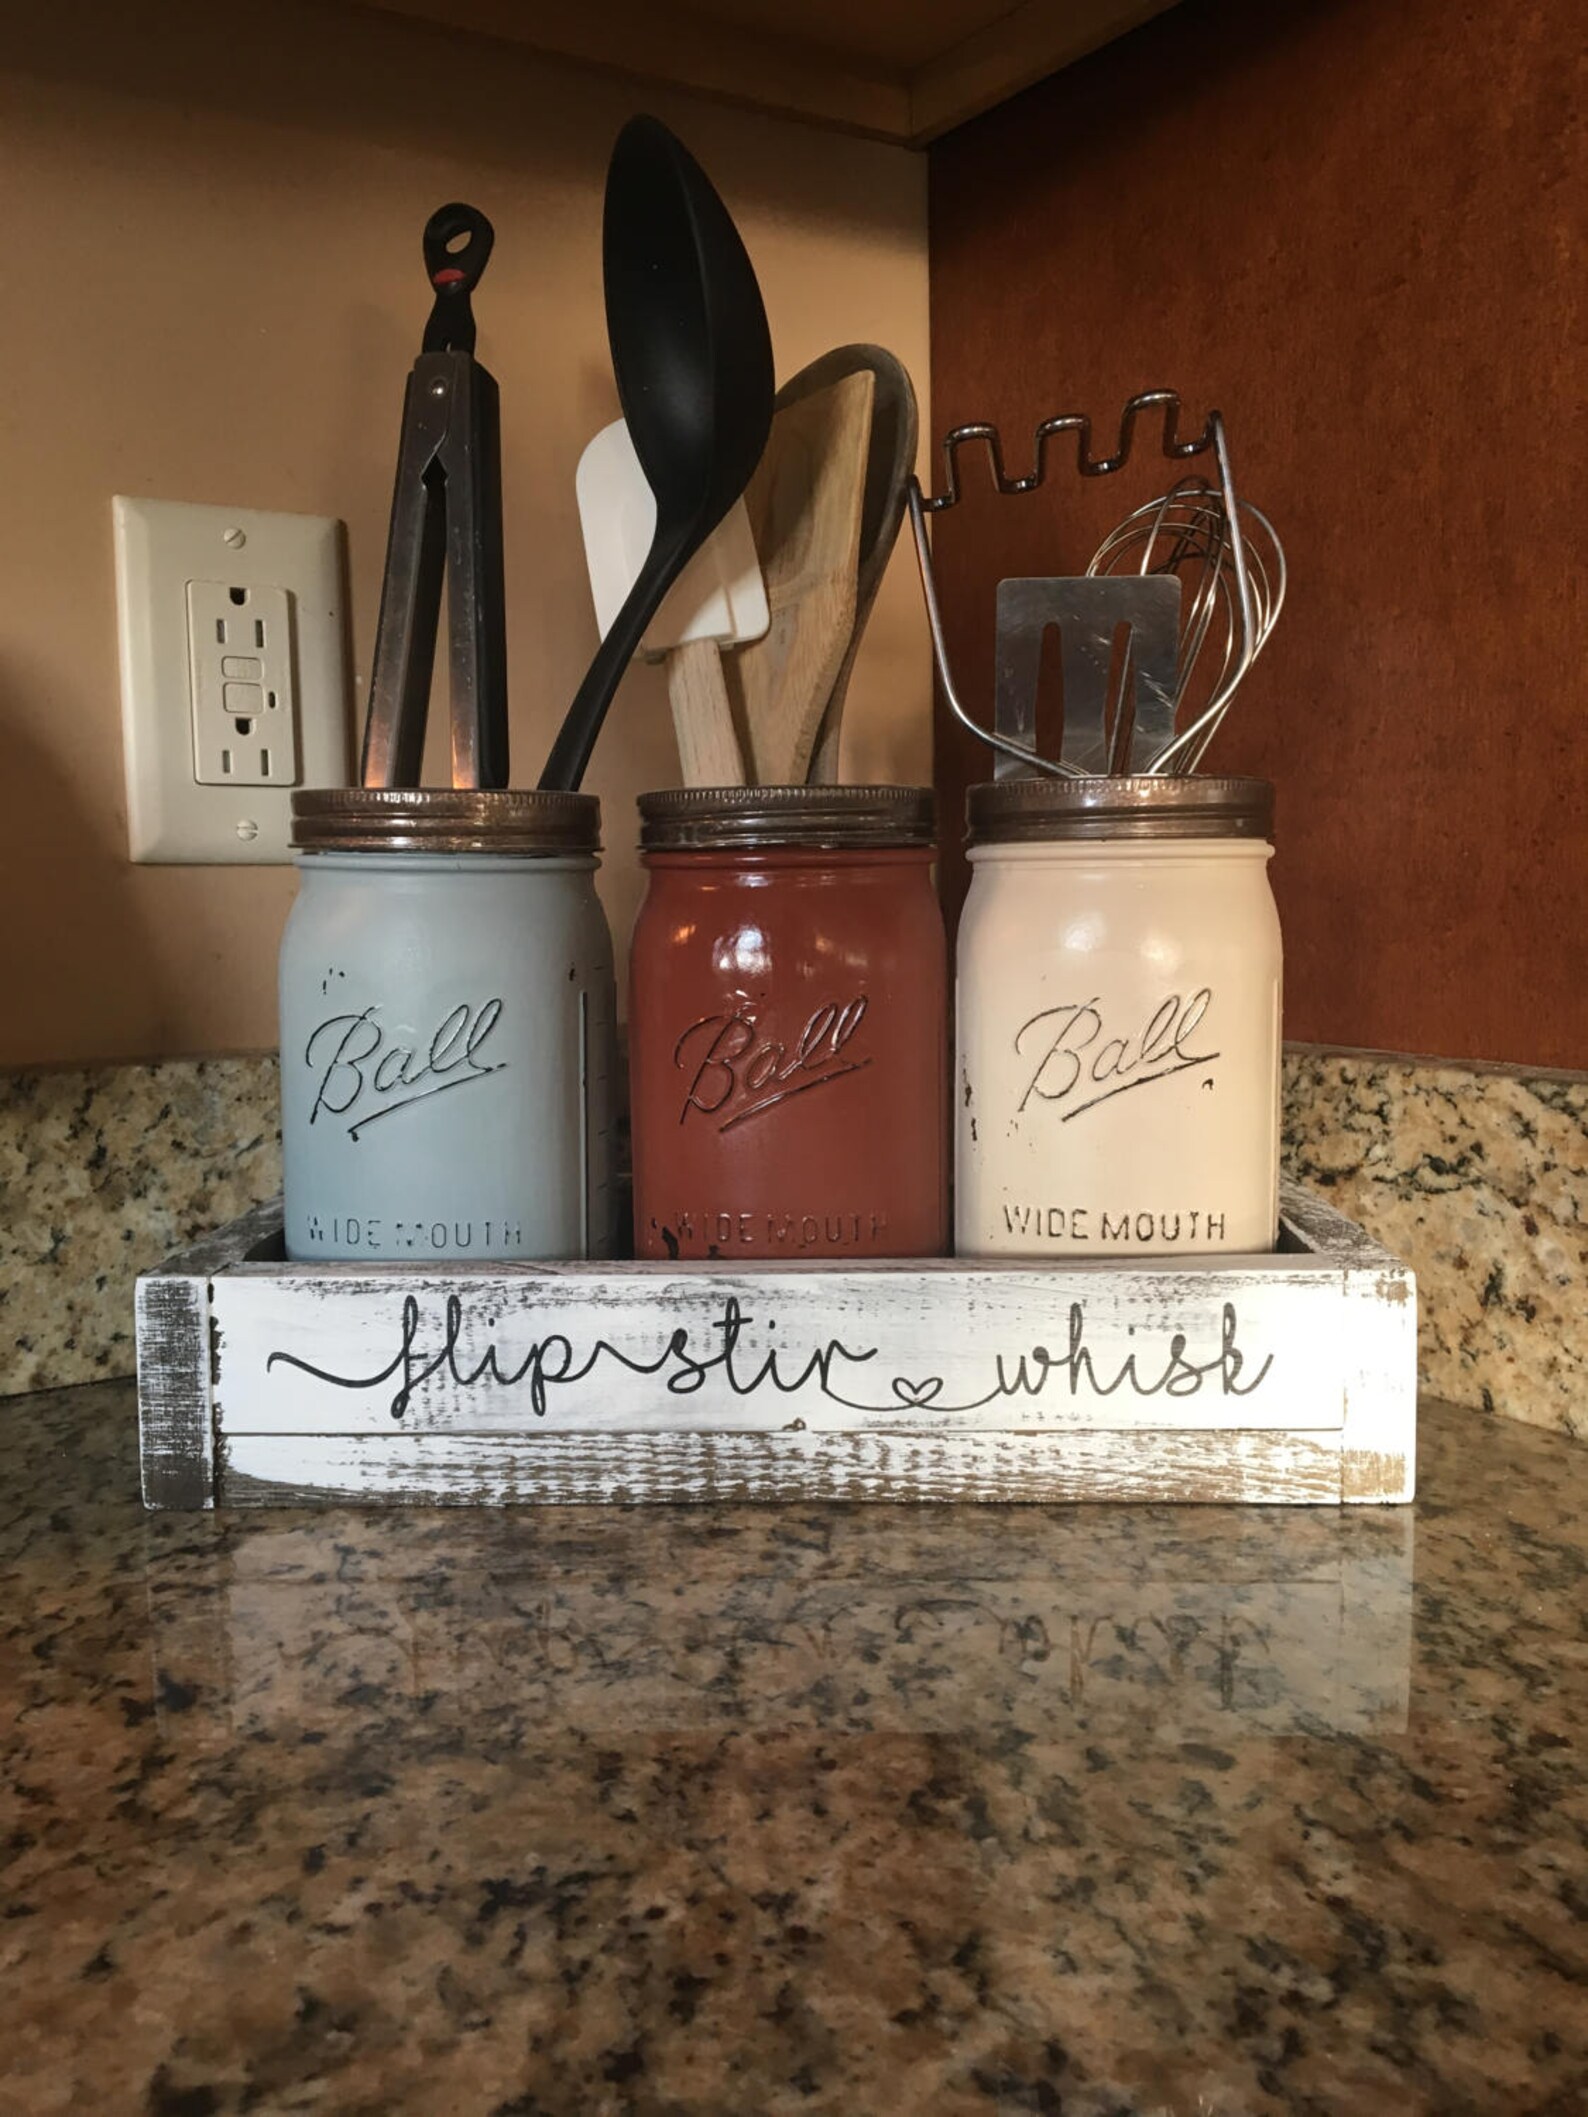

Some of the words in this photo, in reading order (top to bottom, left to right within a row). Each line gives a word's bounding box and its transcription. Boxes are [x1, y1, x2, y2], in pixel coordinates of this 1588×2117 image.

[305, 998, 507, 1137] Ball
[674, 996, 875, 1132] Ball
[1015, 987, 1220, 1121] Ball
[307, 1214, 382, 1246] WIDE
[677, 1212, 754, 1242] WIDE
[768, 1213, 890, 1244] MOUTH
[1004, 1205, 1089, 1240] WIDE
[1101, 1211, 1226, 1242] MOUTH
[267, 1295, 606, 1417] flip
[650, 1297, 878, 1395] stir
[996, 1302, 1274, 1397] whisk
